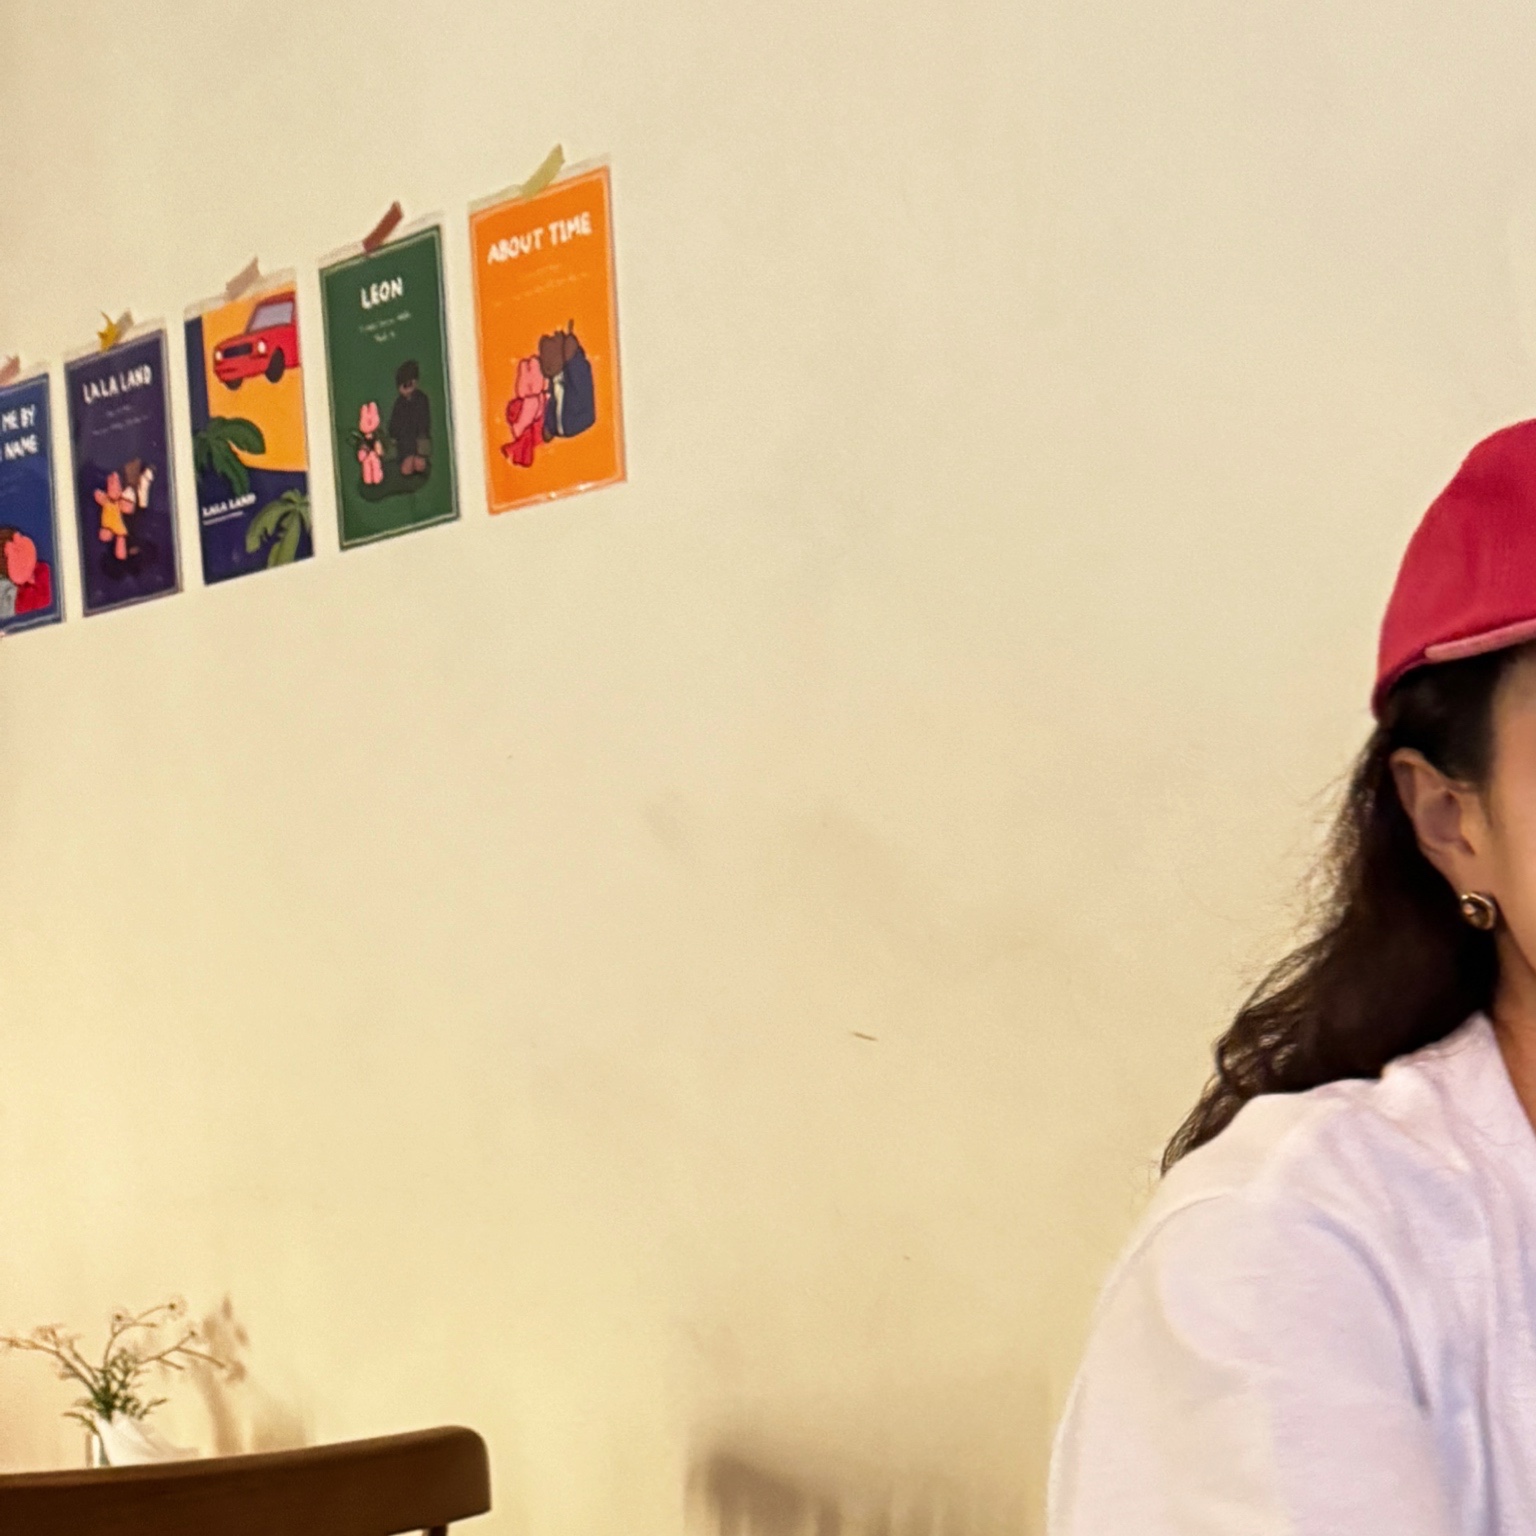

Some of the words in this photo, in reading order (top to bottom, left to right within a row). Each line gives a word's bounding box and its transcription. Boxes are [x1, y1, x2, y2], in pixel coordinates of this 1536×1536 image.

[486, 227, 544, 265] ABOUT
[548, 211, 592, 246] TIME
[360, 277, 403, 310] LEON
[119, 365, 152, 392] LAND
[2, 410, 19, 432] ME
[20, 404, 36, 428] BY
[4, 434, 38, 460] NAME
